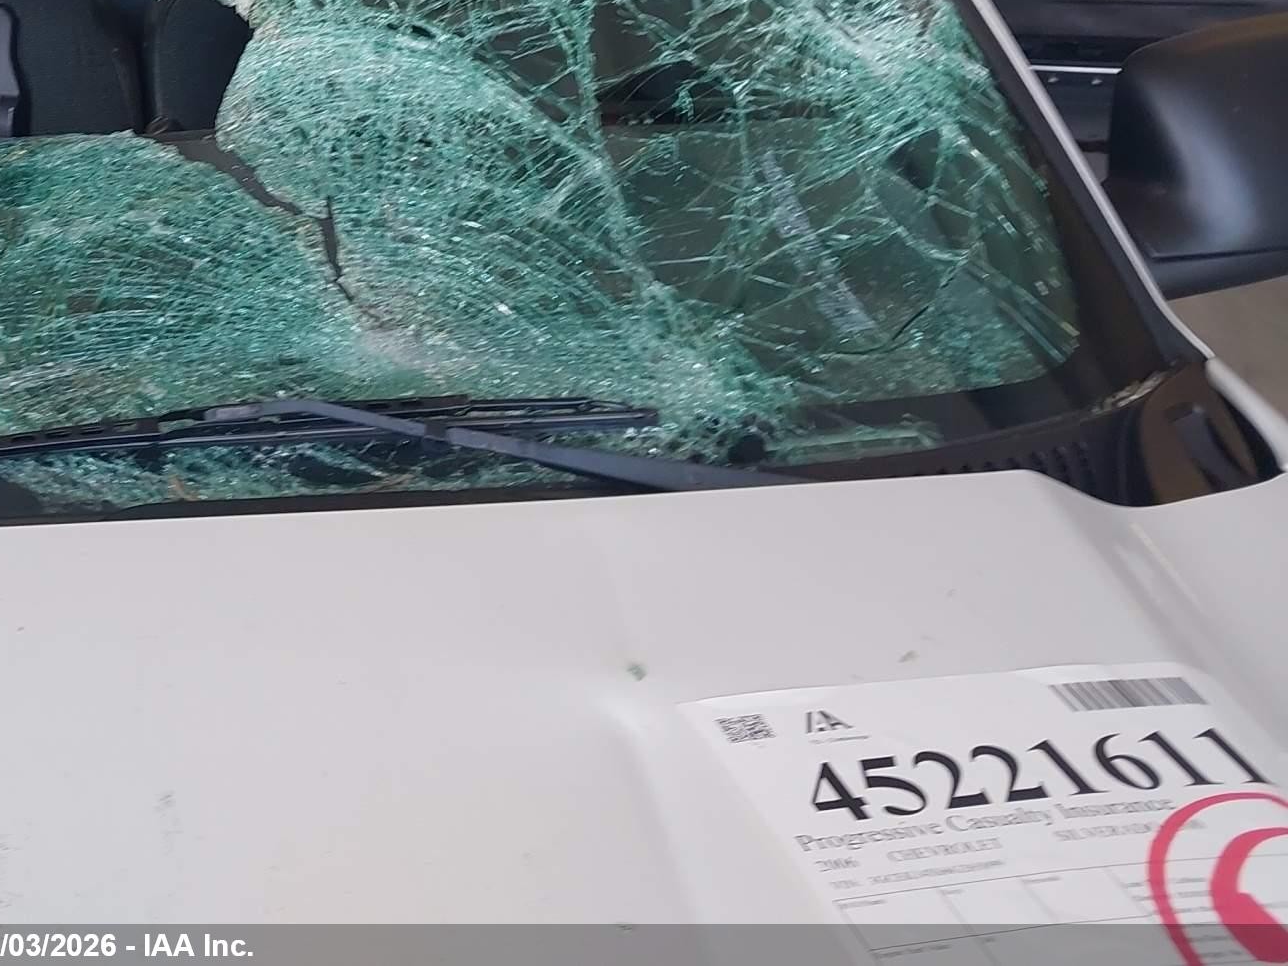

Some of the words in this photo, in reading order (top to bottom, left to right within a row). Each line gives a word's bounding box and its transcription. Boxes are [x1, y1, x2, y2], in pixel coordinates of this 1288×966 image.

[812, 728, 1273, 821] 45221611
[795, 821, 944, 853] Progressive
[946, 808, 1053, 833] Casualty
[1055, 799, 1176, 819] Insurance
[886, 837, 1004, 862] CHEVROLET
